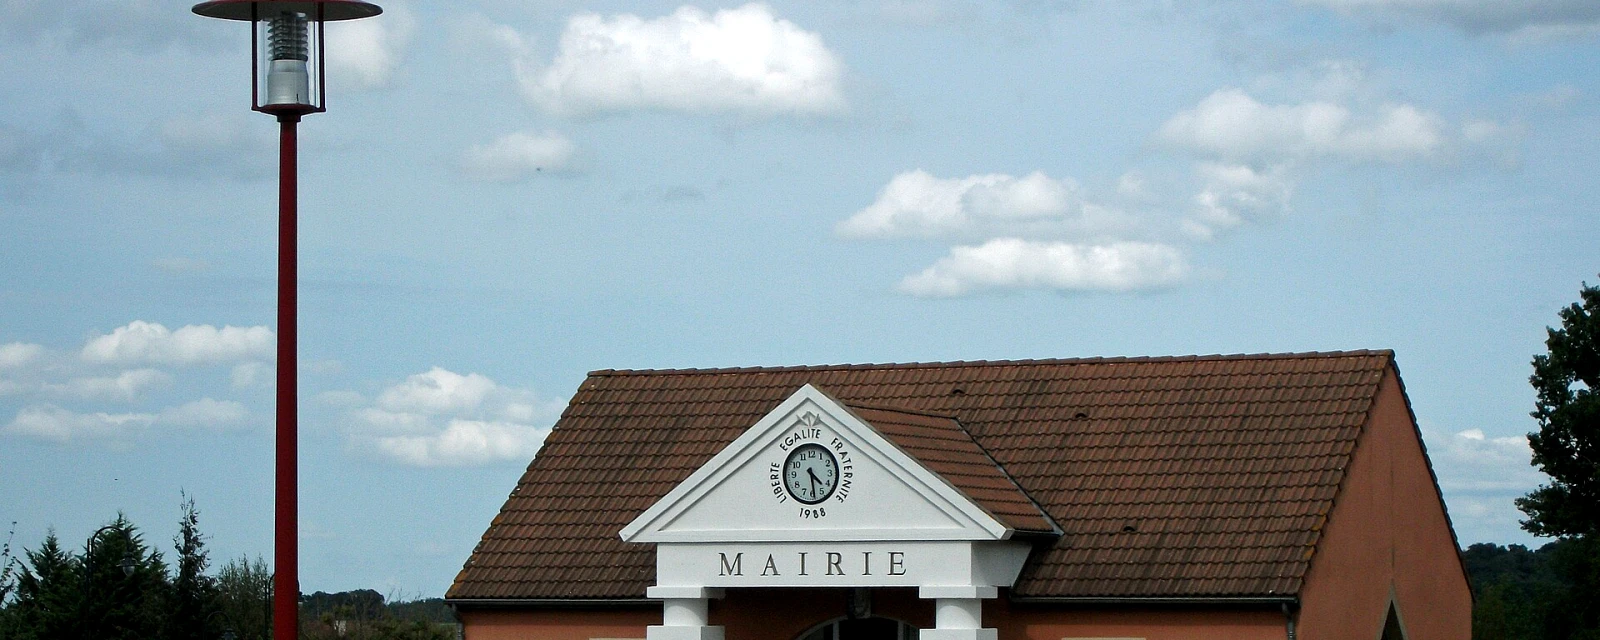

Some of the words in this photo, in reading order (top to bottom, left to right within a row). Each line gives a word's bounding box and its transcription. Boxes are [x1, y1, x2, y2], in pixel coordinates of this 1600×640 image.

[808, 450, 816, 458] 12
[819, 452, 823, 460] 1
[770, 462, 787, 503] LIBERTE
[779, 428, 821, 452] EGALITE
[830, 437, 853, 503] FRATERNITE
[792, 461, 801, 469] 10
[825, 479, 830, 487] 4
[801, 488, 807, 496] 7
[799, 507, 826, 519] 1988
[718, 552, 907, 576] MAIRIE
